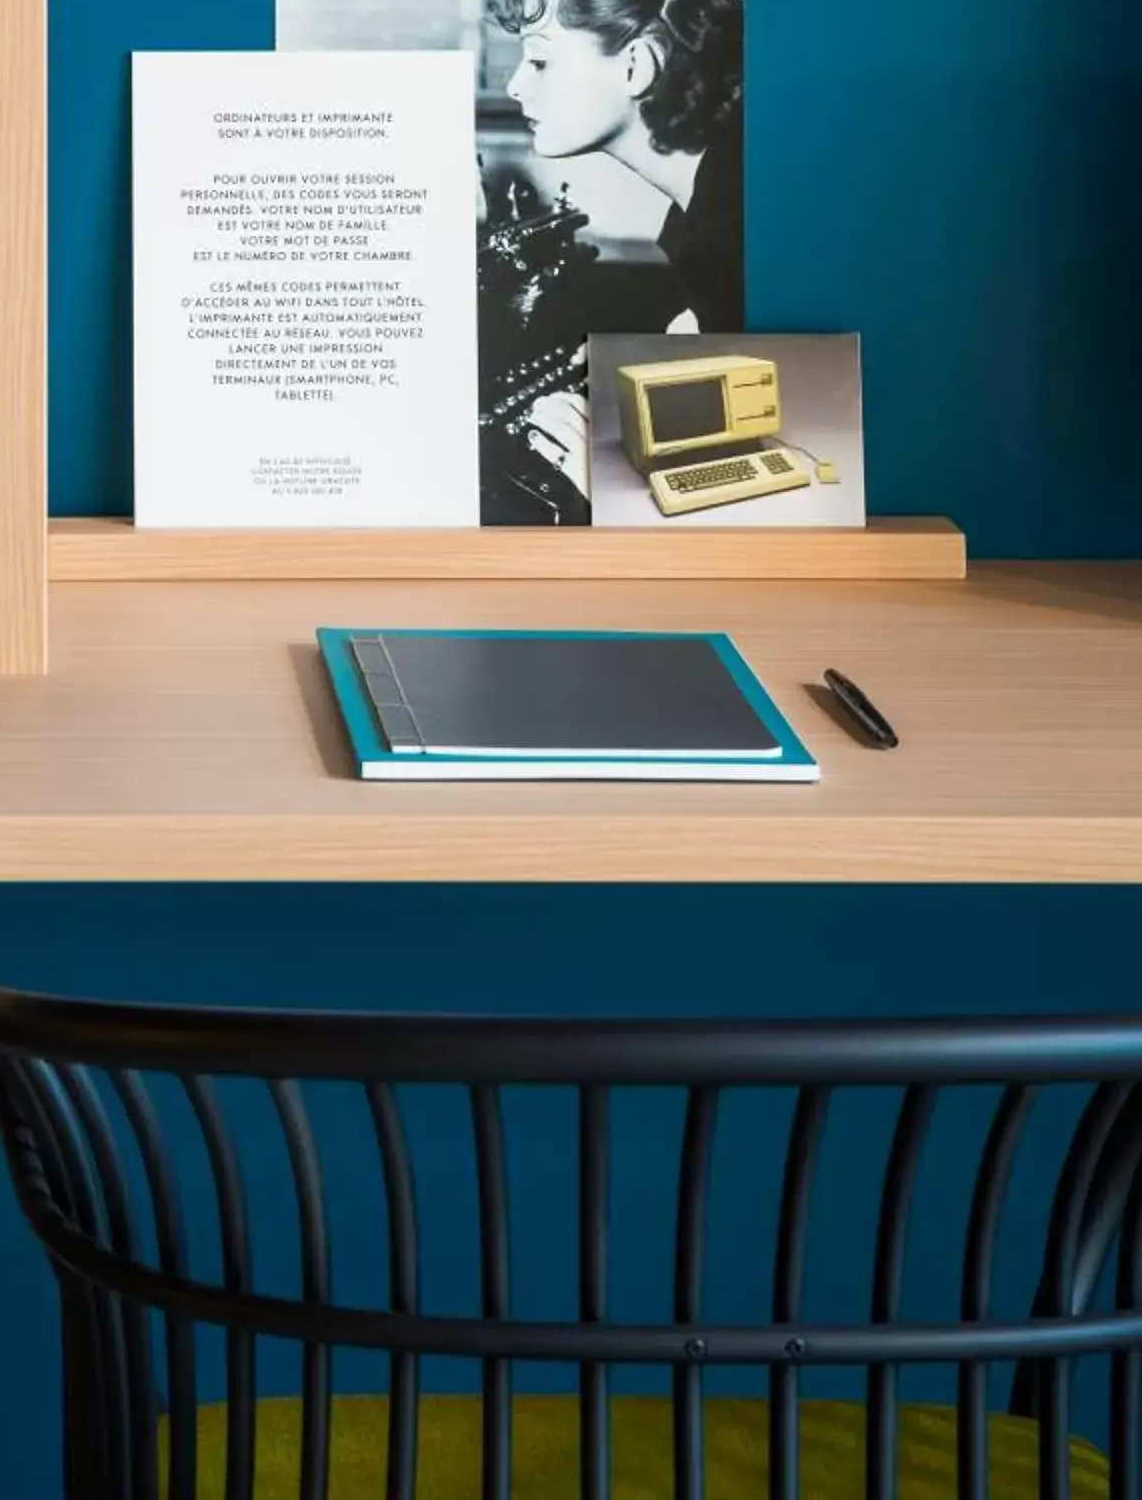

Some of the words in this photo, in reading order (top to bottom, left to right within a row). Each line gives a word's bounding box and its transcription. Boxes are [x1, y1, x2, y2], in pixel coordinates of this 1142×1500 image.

[213, 112, 297, 123] ORDINATEURS
[301, 112, 314, 123] ET
[318, 112, 394, 123] IMPRIMANTE
[217, 127, 249, 139] SONT
[266, 127, 305, 139] VOTRE
[309, 127, 389, 139] DISPOSITION.
[213, 173, 247, 185] POUR
[250, 173, 296, 185] OUVRIR
[301, 173, 340, 185] VOTRE
[345, 173, 395, 185] SESSION
[273, 189, 295, 200] DES
[299, 189, 339, 200] CODES
[344, 189, 377, 200] VOUS
[382, 189, 428, 200] SERONT
[260, 204, 299, 215] VOTRE
[303, 204, 333, 215] NOM
[338, 204, 423, 215] D'UTILISATEUR
[217, 219, 237, 230] EST
[242, 219, 280, 230] VOTRE
[284, 219, 315, 230] NOM
[319, 219, 333, 230] DE
[240, 235, 278, 246] VOTRE
[284, 235, 309, 246] MOT
[314, 235, 328, 246] DE
[333, 235, 368, 246] PASSE
[193, 251, 213, 261] EST
[216, 251, 230, 261] LE
[234, 251, 287, 261] NUMÉRO
[291, 251, 305, 261] DE
[310, 251, 349, 261] VOTRE
[209, 281, 233, 293] CES
[236, 281, 277, 293] MÊMES
[281, 281, 322, 293] CODES
[325, 281, 401, 293] PERMETTENT
[181, 296, 249, 308] D'ACCÉDER
[253, 296, 271, 308] AU
[275, 296, 301, 308] WIFI
[305, 296, 338, 308] DANS
[343, 296, 373, 308] TOUT
[189, 312, 273, 323] L'IMPRIMANTE
[278, 312, 297, 323] EST
[302, 312, 422, 323] AUTOMATIQUEMENT
[187, 327, 258, 338] CONNECTÉE
[263, 327, 281, 338] AU
[338, 327, 371, 338] VOUS
[375, 327, 424, 338] POUVEZ
[228, 343, 276, 354] LANCER
[281, 343, 304, 354] UNE
[309, 343, 383, 354] IMPRESSION
[215, 358, 296, 369] DIRECTEMENT
[301, 358, 315, 369] DE
[321, 358, 347, 369] L'UN
[351, 358, 366, 369] DE
[370, 358, 397, 369] VOS
[212, 374, 281, 386] TERMINAUX
